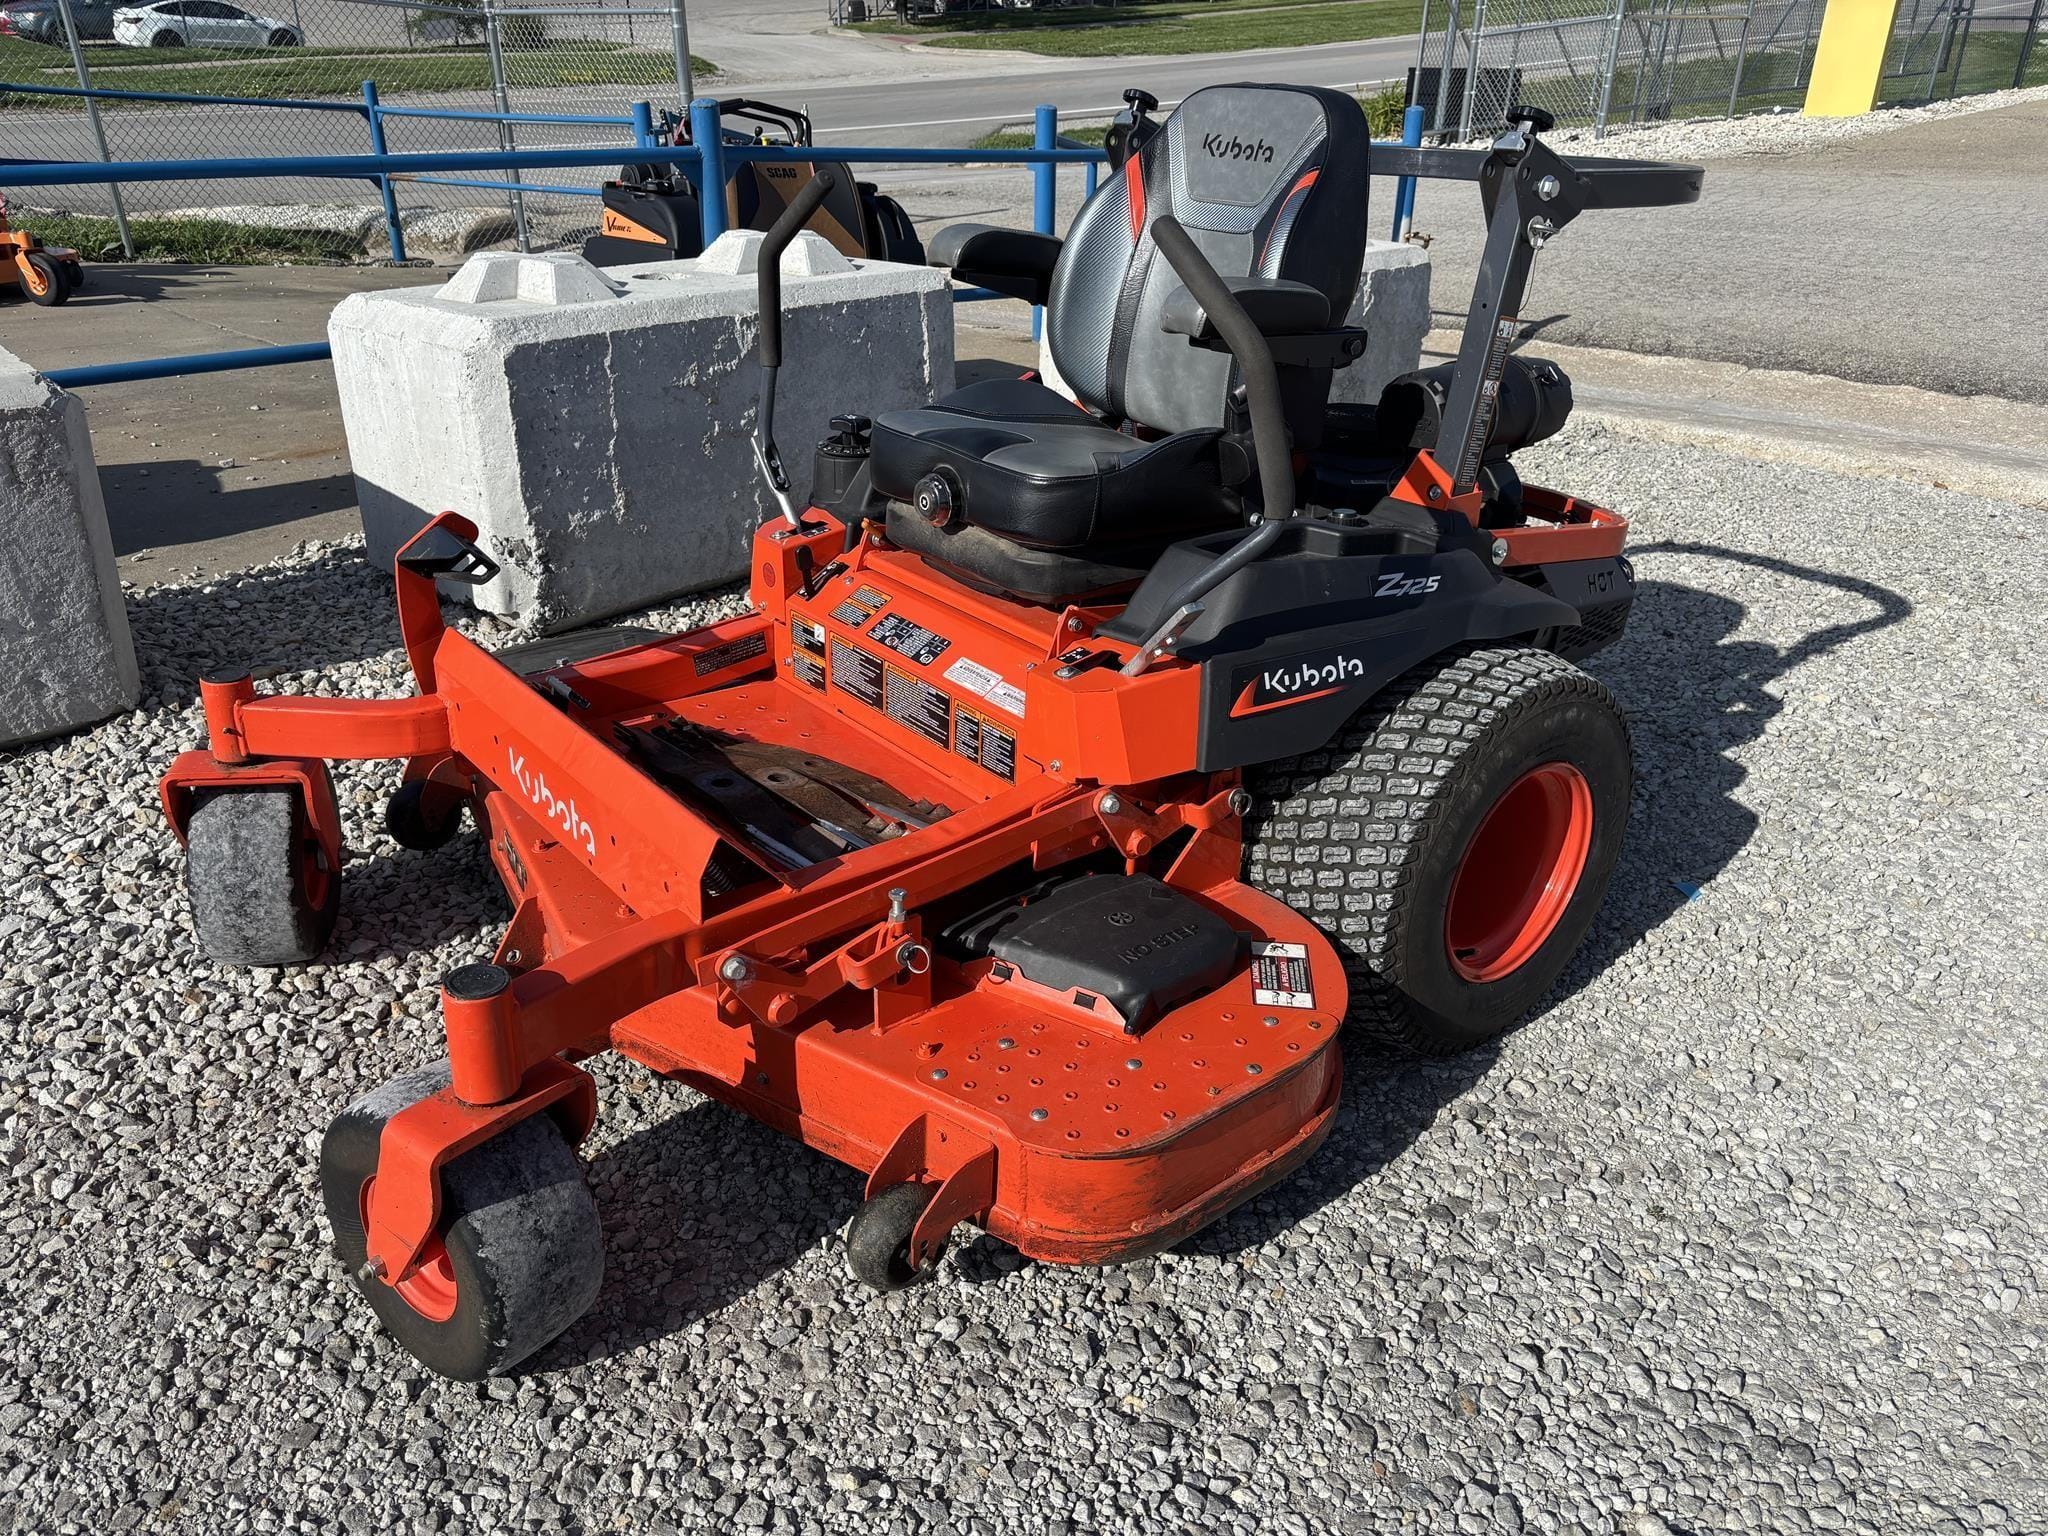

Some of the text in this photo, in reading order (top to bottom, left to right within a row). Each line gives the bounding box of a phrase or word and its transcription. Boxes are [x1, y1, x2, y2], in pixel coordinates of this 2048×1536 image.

[1202, 133, 1275, 163] Kubota
[766, 167, 797, 178] SCAG
[1374, 572, 1441, 597] Z725
[1587, 571, 1614, 594] HOT
[1263, 655, 1364, 693] Kubota
[508, 746, 596, 857] Kubota
[1117, 944, 1152, 965] NO
